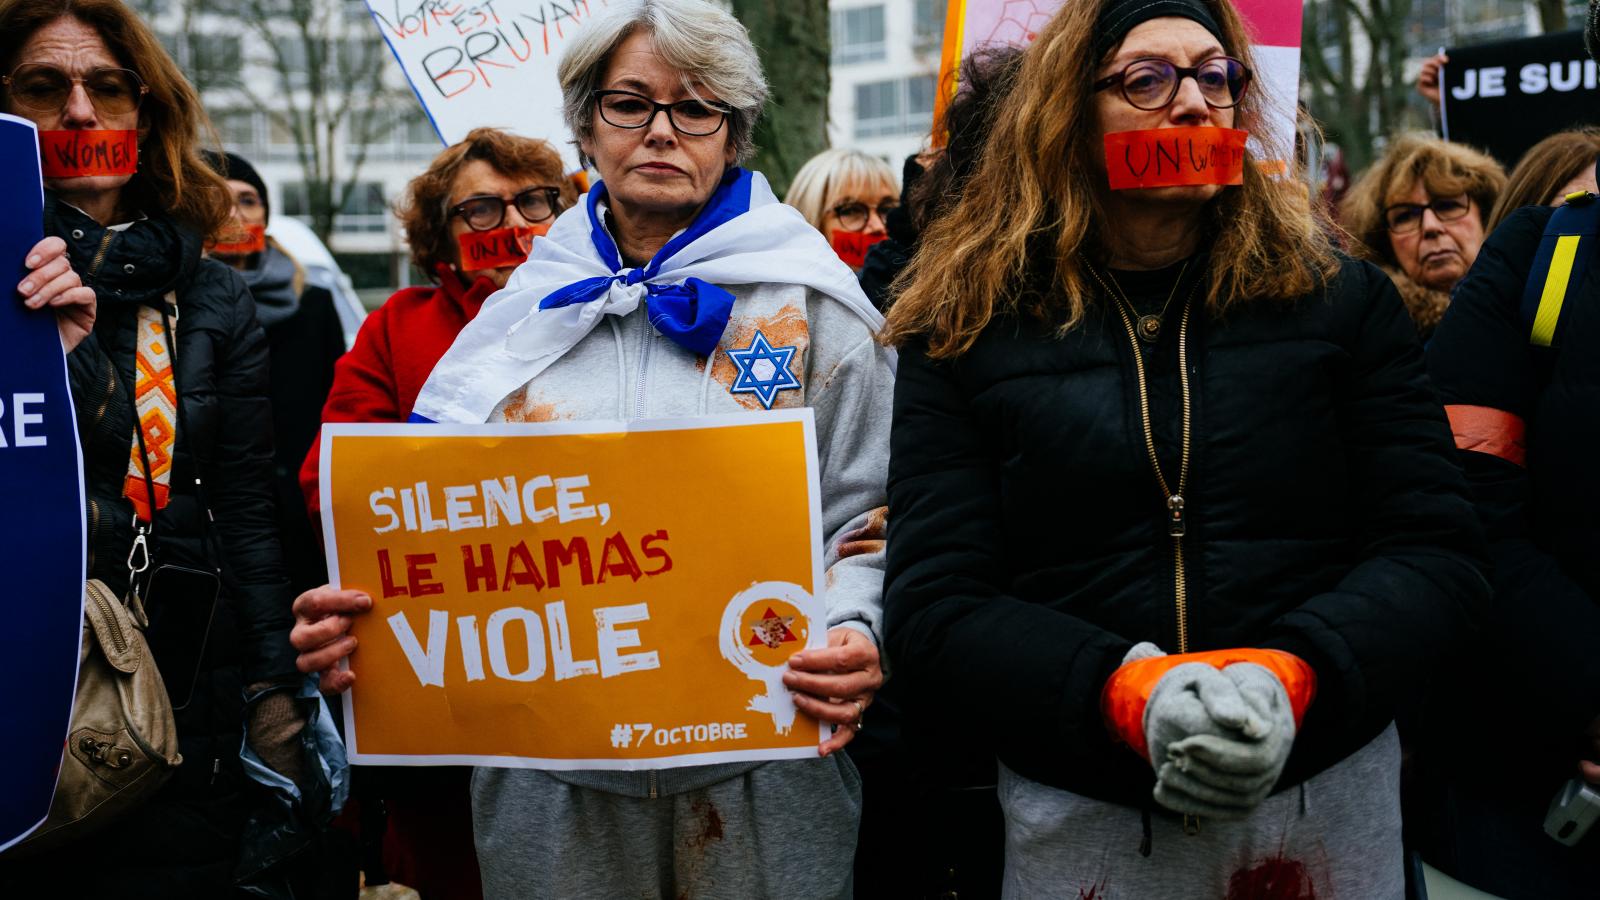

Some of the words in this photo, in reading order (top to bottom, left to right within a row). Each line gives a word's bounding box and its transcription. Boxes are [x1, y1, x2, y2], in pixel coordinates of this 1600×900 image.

[1452, 66, 1506, 100] JE
[1519, 58, 1600, 94] SUI
[54, 132, 131, 170] WOMEN
[1125, 138, 1180, 177] UN
[470, 237, 498, 260] UN
[0, 392, 47, 448] E
[369, 475, 612, 534] SILENCE,
[377, 548, 444, 598] LE
[461, 529, 673, 593] HAMAS
[387, 600, 660, 687] VIOLE
